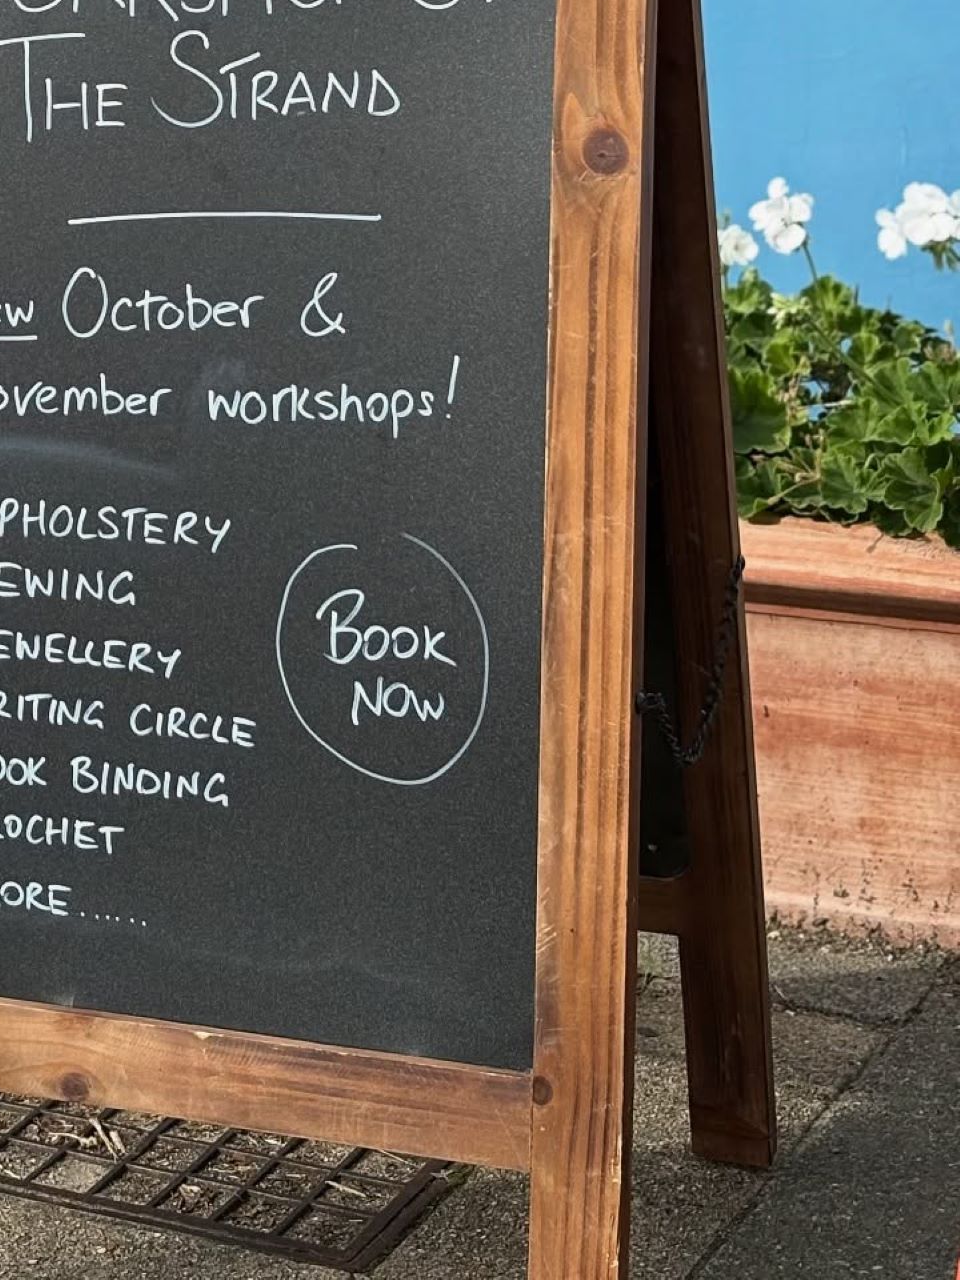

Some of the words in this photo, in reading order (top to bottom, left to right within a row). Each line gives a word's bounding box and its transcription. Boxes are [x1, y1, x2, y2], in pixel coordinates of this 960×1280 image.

[150, 29, 401, 129] STRAND
[61, 266, 265, 339] October
[300, 271, 346, 338] &
[207, 354, 461, 439] workshops!
[129, 703, 257, 748] CIRCLE
[351, 676, 445, 726] NOW
[69, 755, 229, 807] BINDING
